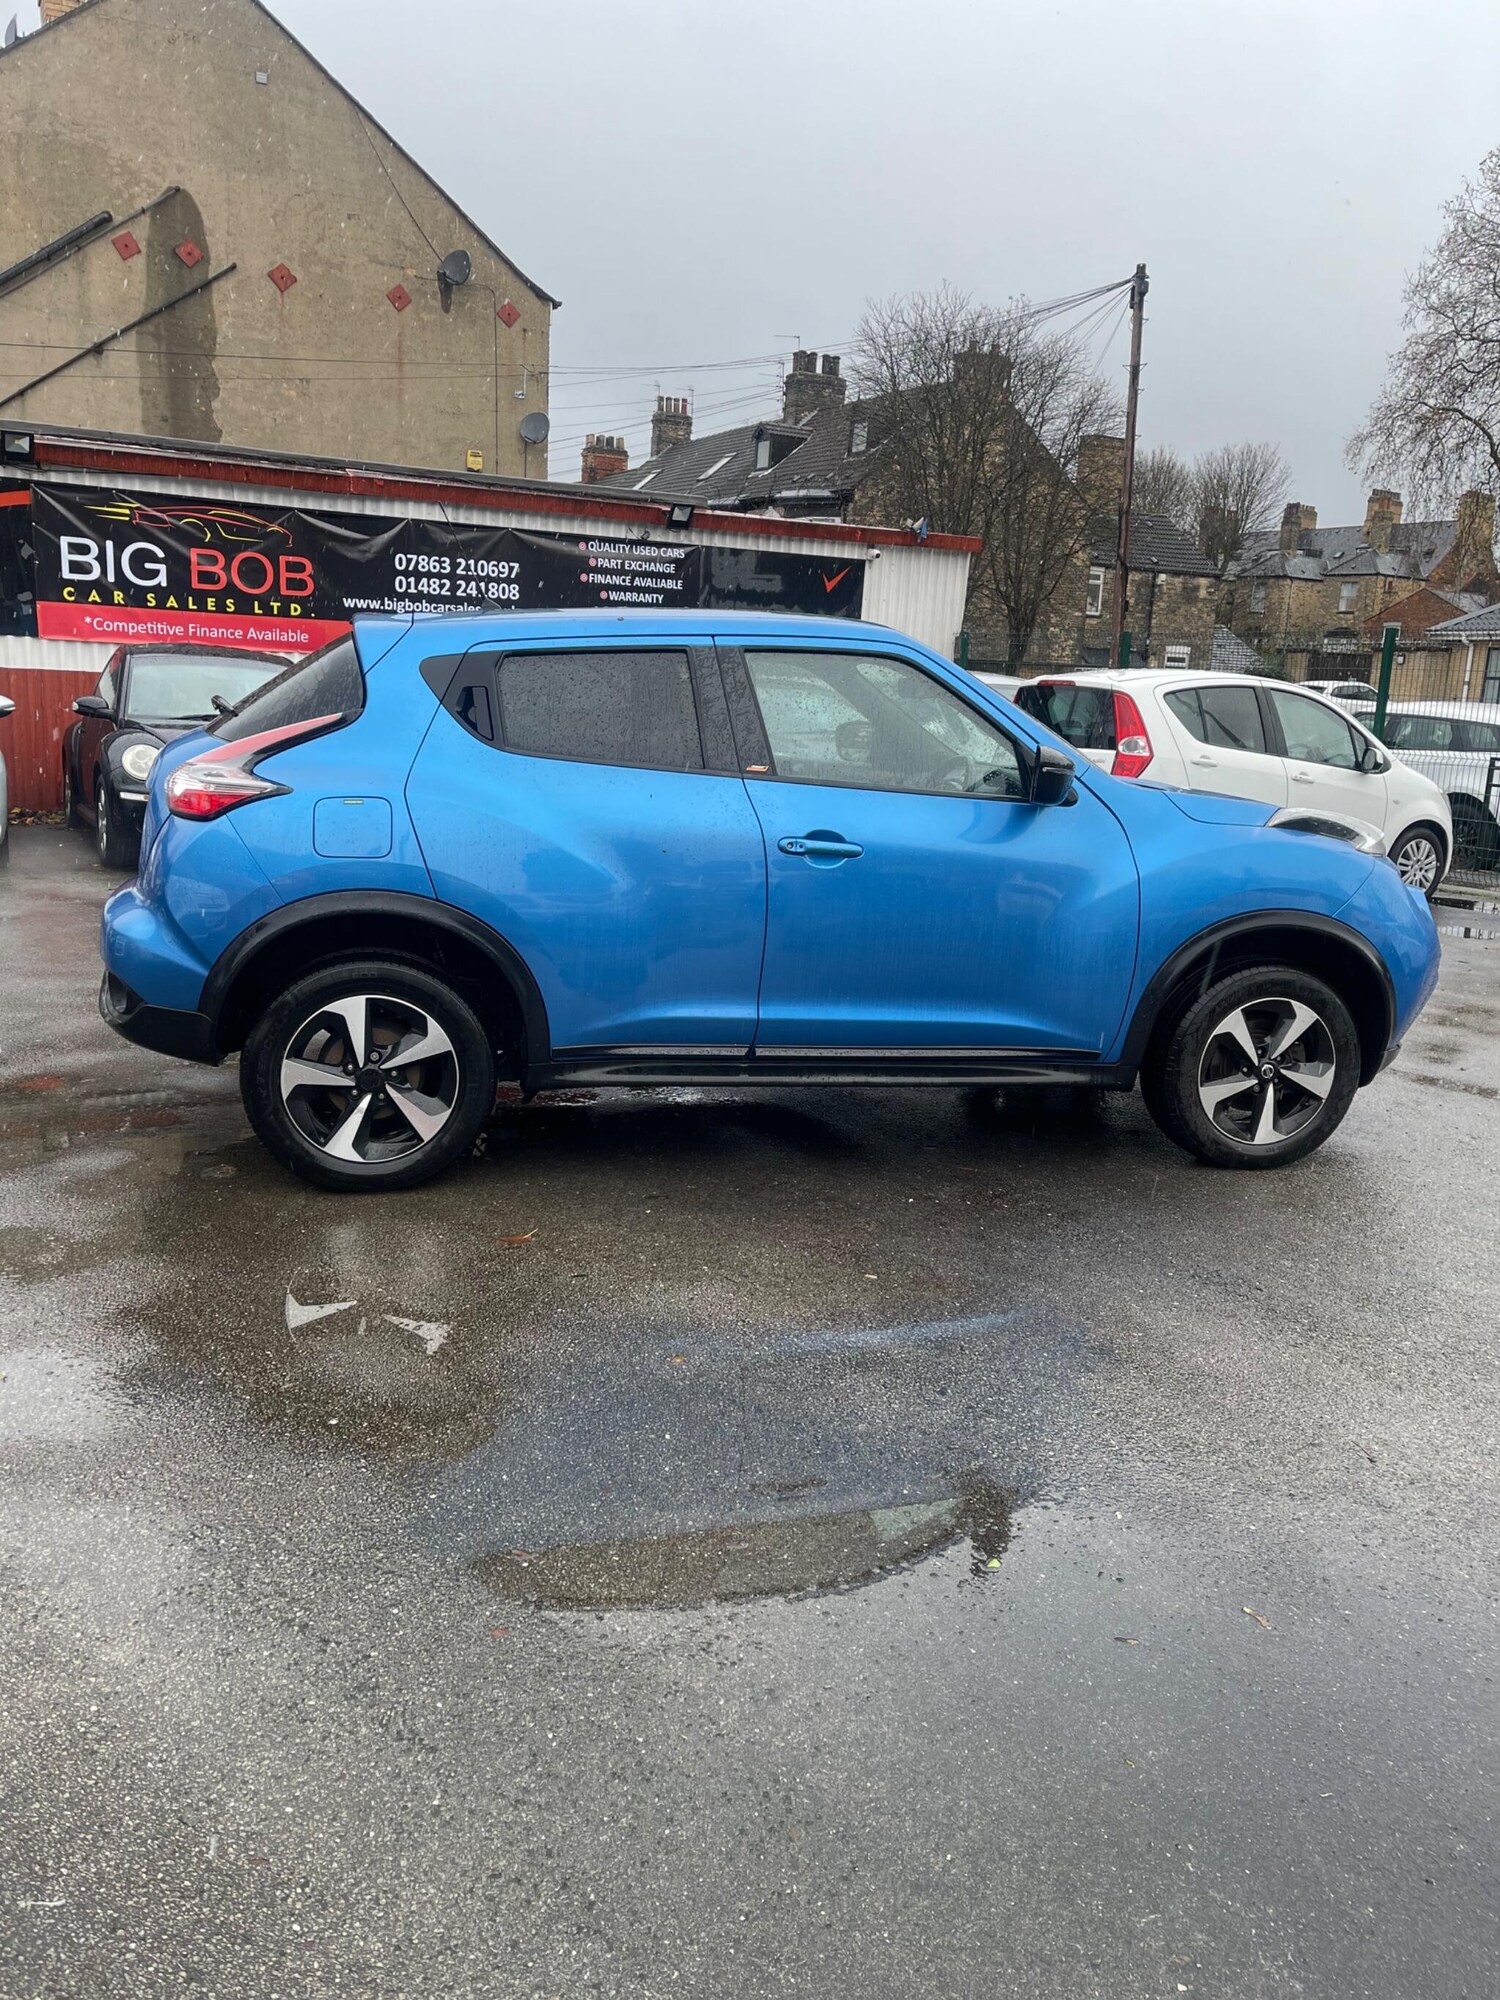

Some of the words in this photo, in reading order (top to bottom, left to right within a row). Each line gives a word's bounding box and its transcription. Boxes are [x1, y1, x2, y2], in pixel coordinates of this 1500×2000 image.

[588, 541, 631, 555] QUALITY
[632, 545, 659, 557] USED
[660, 547, 685, 559] CARS
[59, 535, 168, 588] BIG
[190, 547, 315, 597] BOB
[394, 553, 451, 574] 07863
[455, 558, 520, 579] 210697
[597, 558, 622, 569] PART
[625, 560, 676, 574] EXCHANGE
[394, 575, 451, 596] 01482
[455, 580, 520, 600] 241808
[588, 573, 632, 586] FINANCE
[633, 577, 683, 590] AVALIABLE
[63, 586, 125, 605] CAR
[146, 593, 235, 613] SALES
[254, 601, 316, 617] LTD.
[608, 590, 664, 604] WARRANTY
[188, 624, 243, 639] Finance
[247, 627, 309, 643] Available
